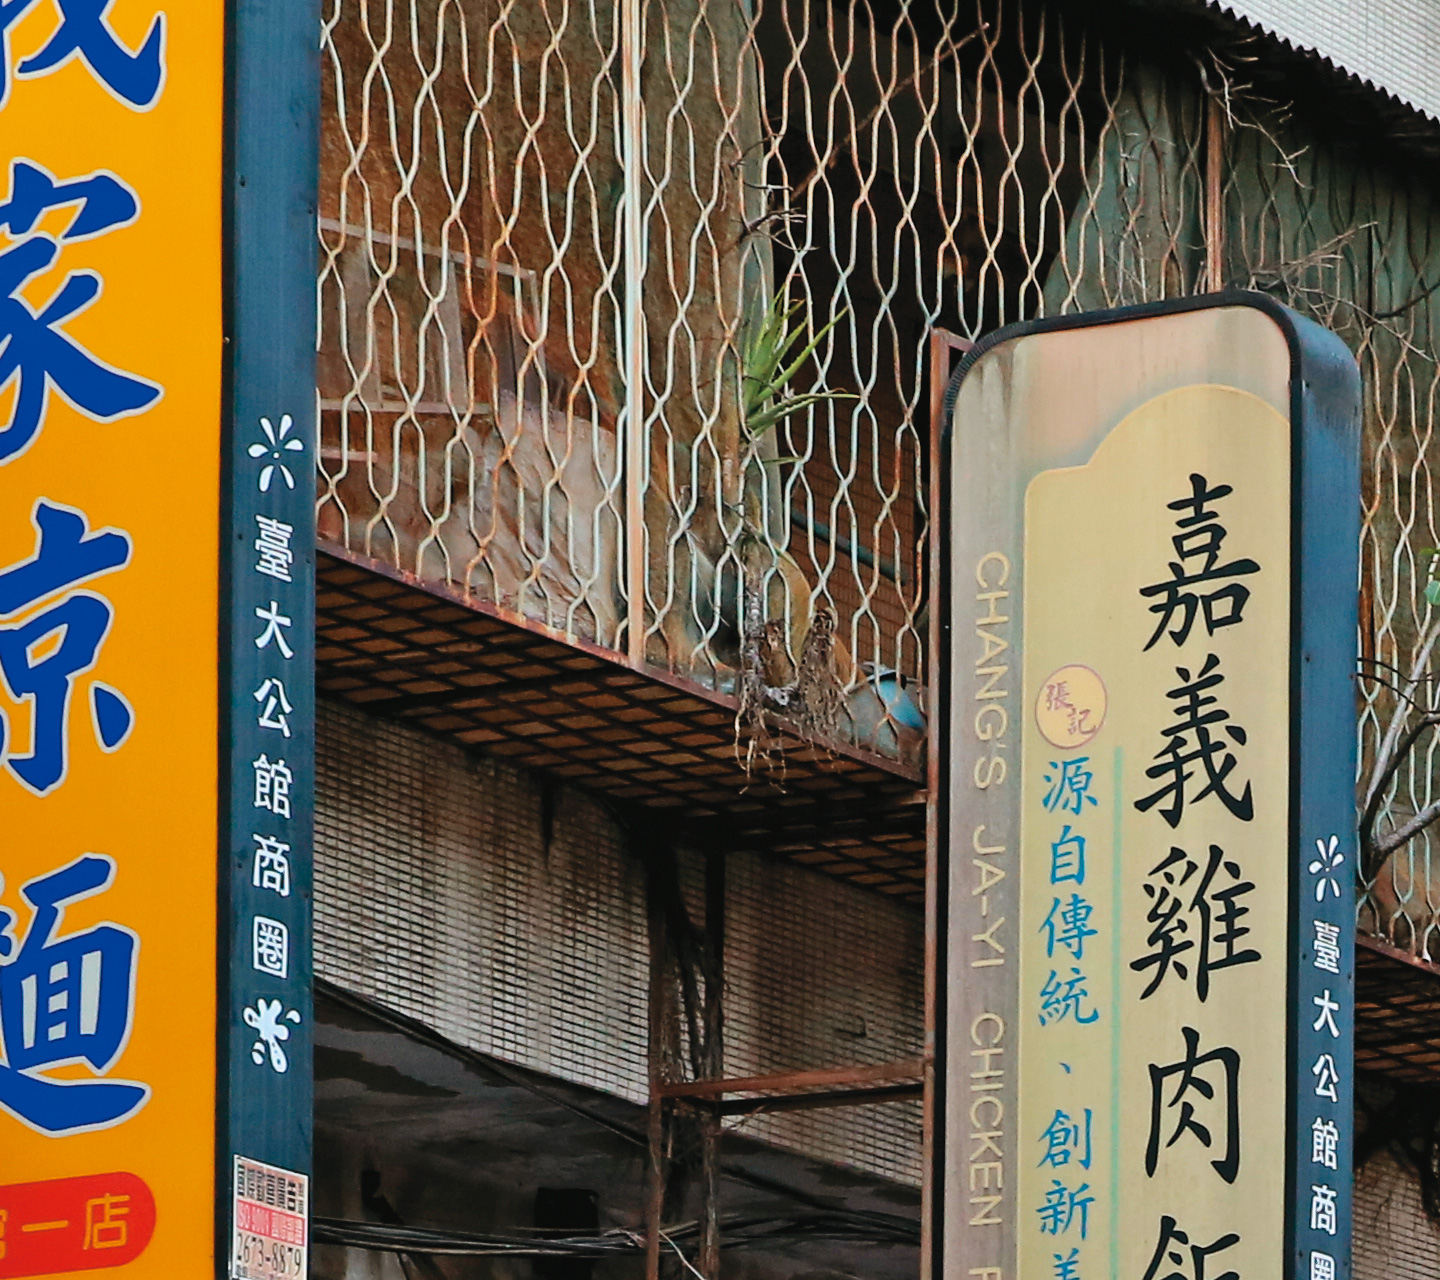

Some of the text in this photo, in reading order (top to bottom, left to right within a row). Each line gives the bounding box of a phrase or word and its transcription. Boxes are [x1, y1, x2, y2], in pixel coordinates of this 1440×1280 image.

[252, 514, 293, 979] 臺大公館商圈
[974, 551, 1011, 791] CHANG'S
[971, 824, 1007, 969] JA-YI
[969, 1012, 1005, 1228] CHICKEN
